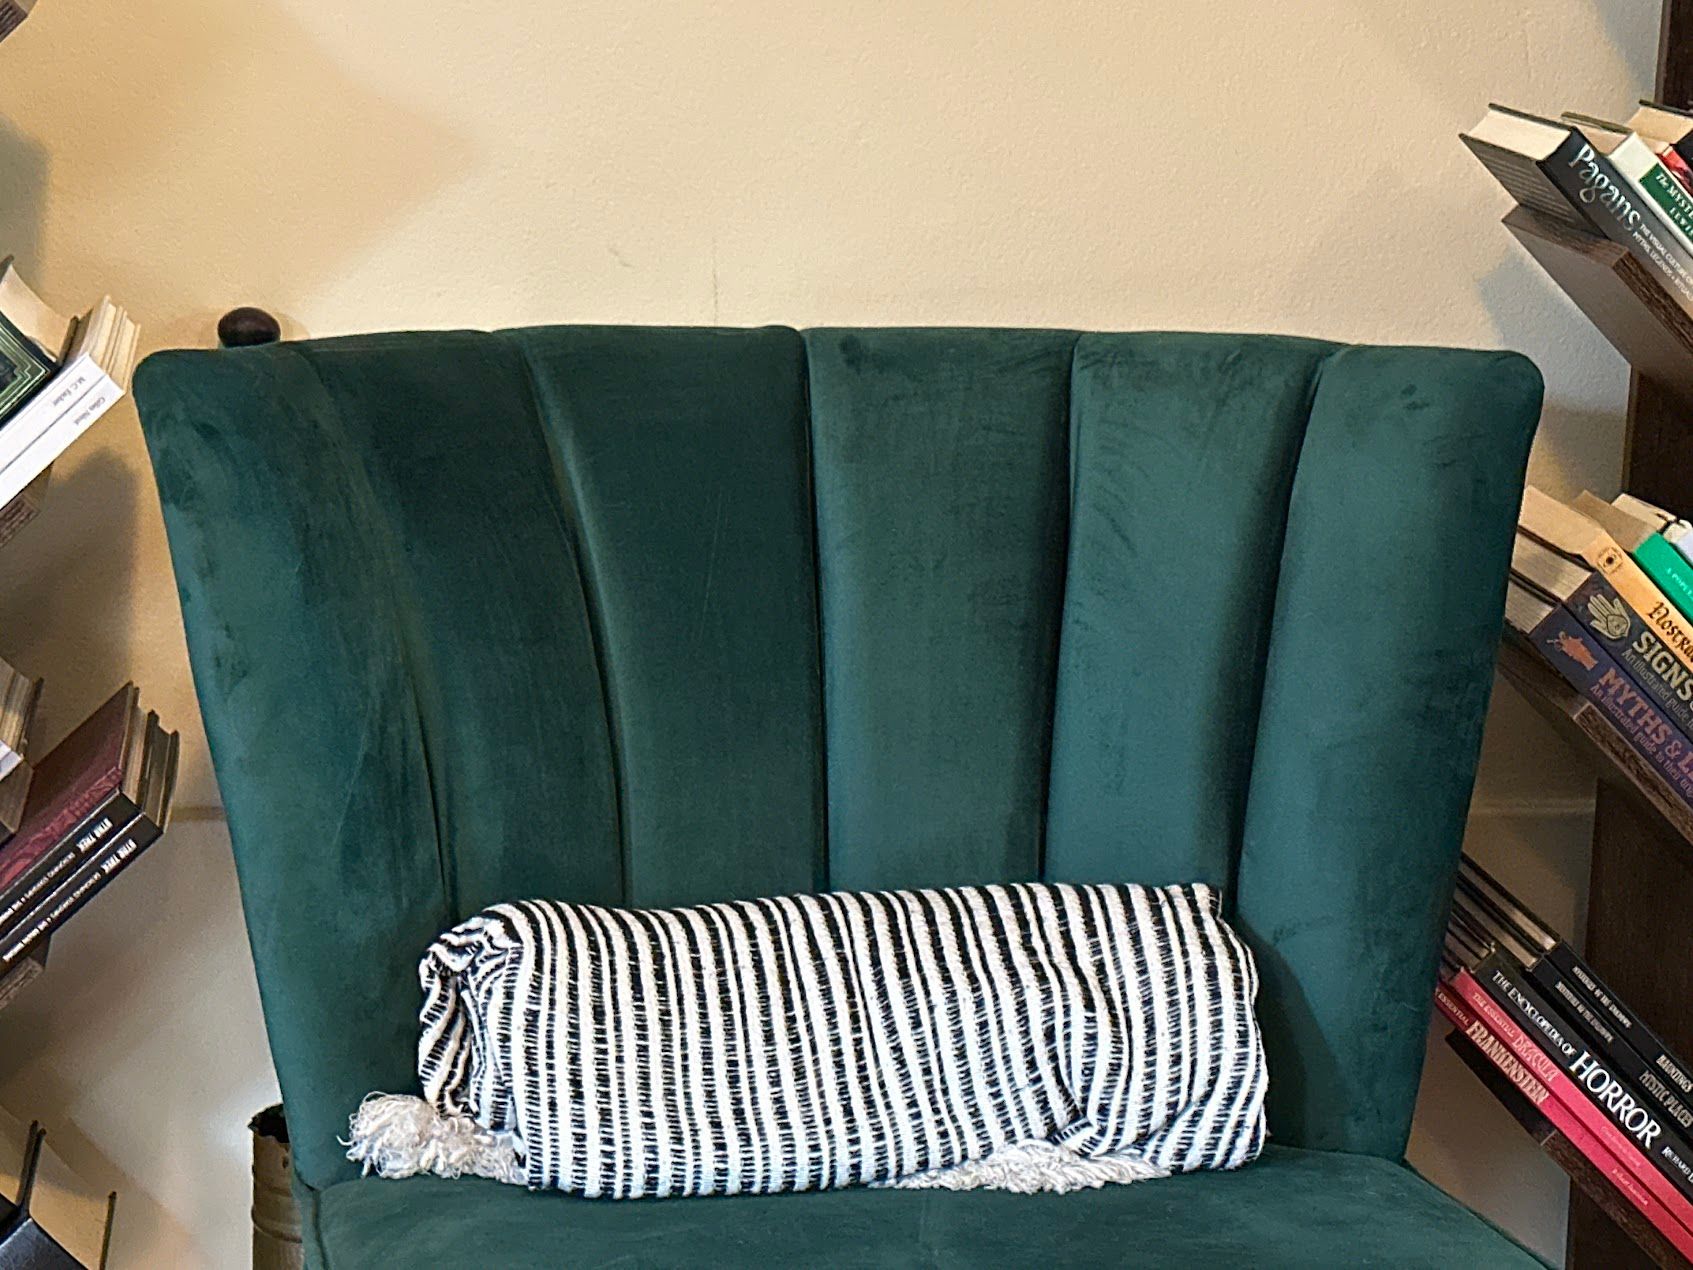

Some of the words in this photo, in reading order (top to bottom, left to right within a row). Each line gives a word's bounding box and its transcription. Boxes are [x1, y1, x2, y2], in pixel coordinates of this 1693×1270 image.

[1568, 143, 1641, 232] Pagans
[1656, 172, 1669, 189] The
[1638, 223, 1651, 236] THE
[1647, 233, 1667, 255] VISUAL
[1589, 682, 1605, 698] An
[1620, 646, 1639, 665] An
[1631, 659, 1672, 701] illustrated
[1664, 696, 1691, 723] guide
[1632, 631, 1693, 701] SIGNS
[1598, 667, 1671, 746] MYTHS
[1665, 741, 1682, 760] &
[1437, 992, 1471, 1025] ESSENTIAL
[1464, 1019, 1549, 1105] FRANKENSTEIN
[1471, 992, 1487, 1007] THE
[1482, 1004, 1516, 1037] ESSENTIAL
[1511, 1033, 1559, 1082] DRACULA
[1490, 970, 1513, 992] THE
[1506, 987, 1566, 1047] ENCYCLOPEDIA
[1559, 1041, 1577, 1058] OF
[1569, 1050, 1662, 1149] HORROR
[1638, 1069, 1669, 1101] MYSTIC
[1662, 1095, 1693, 1128] PLACES
[1655, 1053, 1693, 1093] HAUNTINGS
[1660, 1145, 1692, 1175] RICHARD
